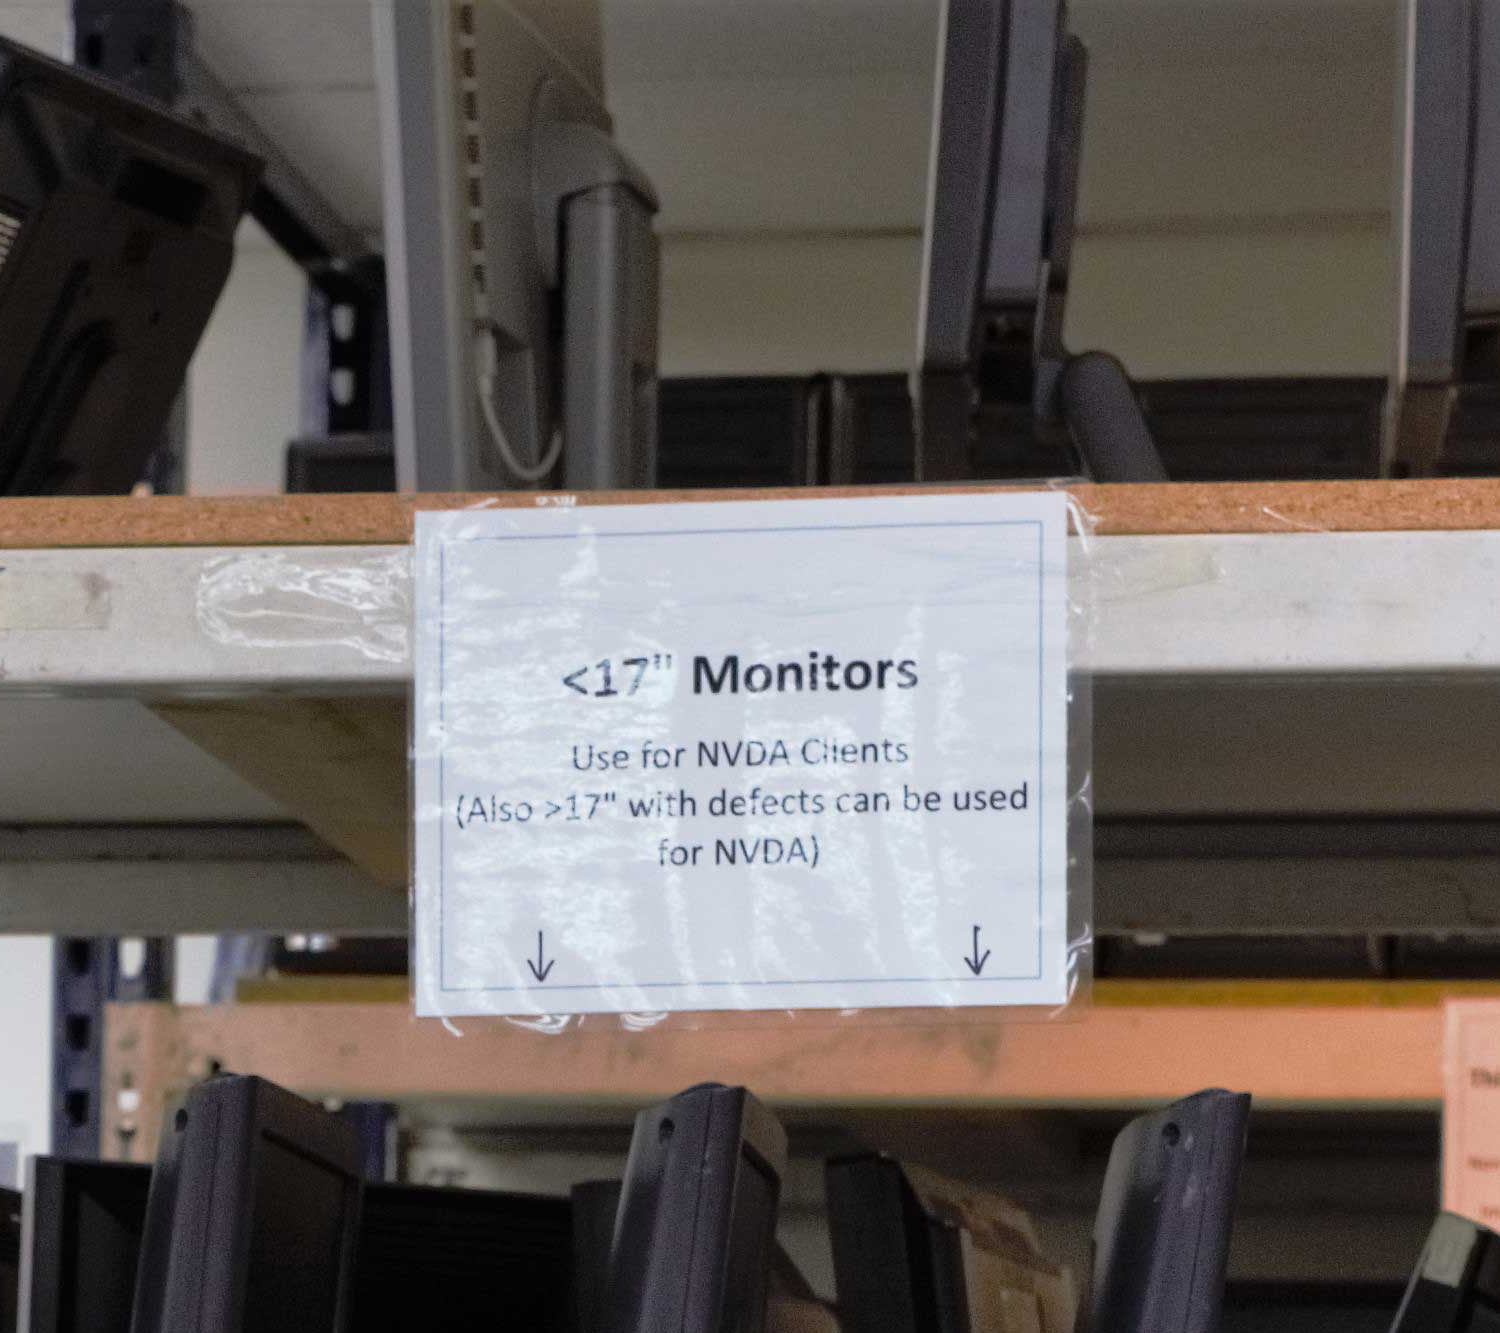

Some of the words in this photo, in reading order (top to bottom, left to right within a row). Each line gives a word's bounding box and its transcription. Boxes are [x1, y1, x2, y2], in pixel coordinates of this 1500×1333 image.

[692, 652, 919, 695] Monitors
[572, 743, 629, 771] Use
[642, 739, 687, 769] for
[698, 739, 790, 768] NVDA
[801, 738, 908, 767] Clients
[456, 792, 533, 827] (Also
[629, 787, 699, 820] with
[709, 785, 825, 817] defects
[837, 790, 889, 814] can
[903, 784, 943, 814] be
[954, 782, 1028, 812] used
[659, 837, 704, 867] for
[715, 836, 820, 870] NVDA)
